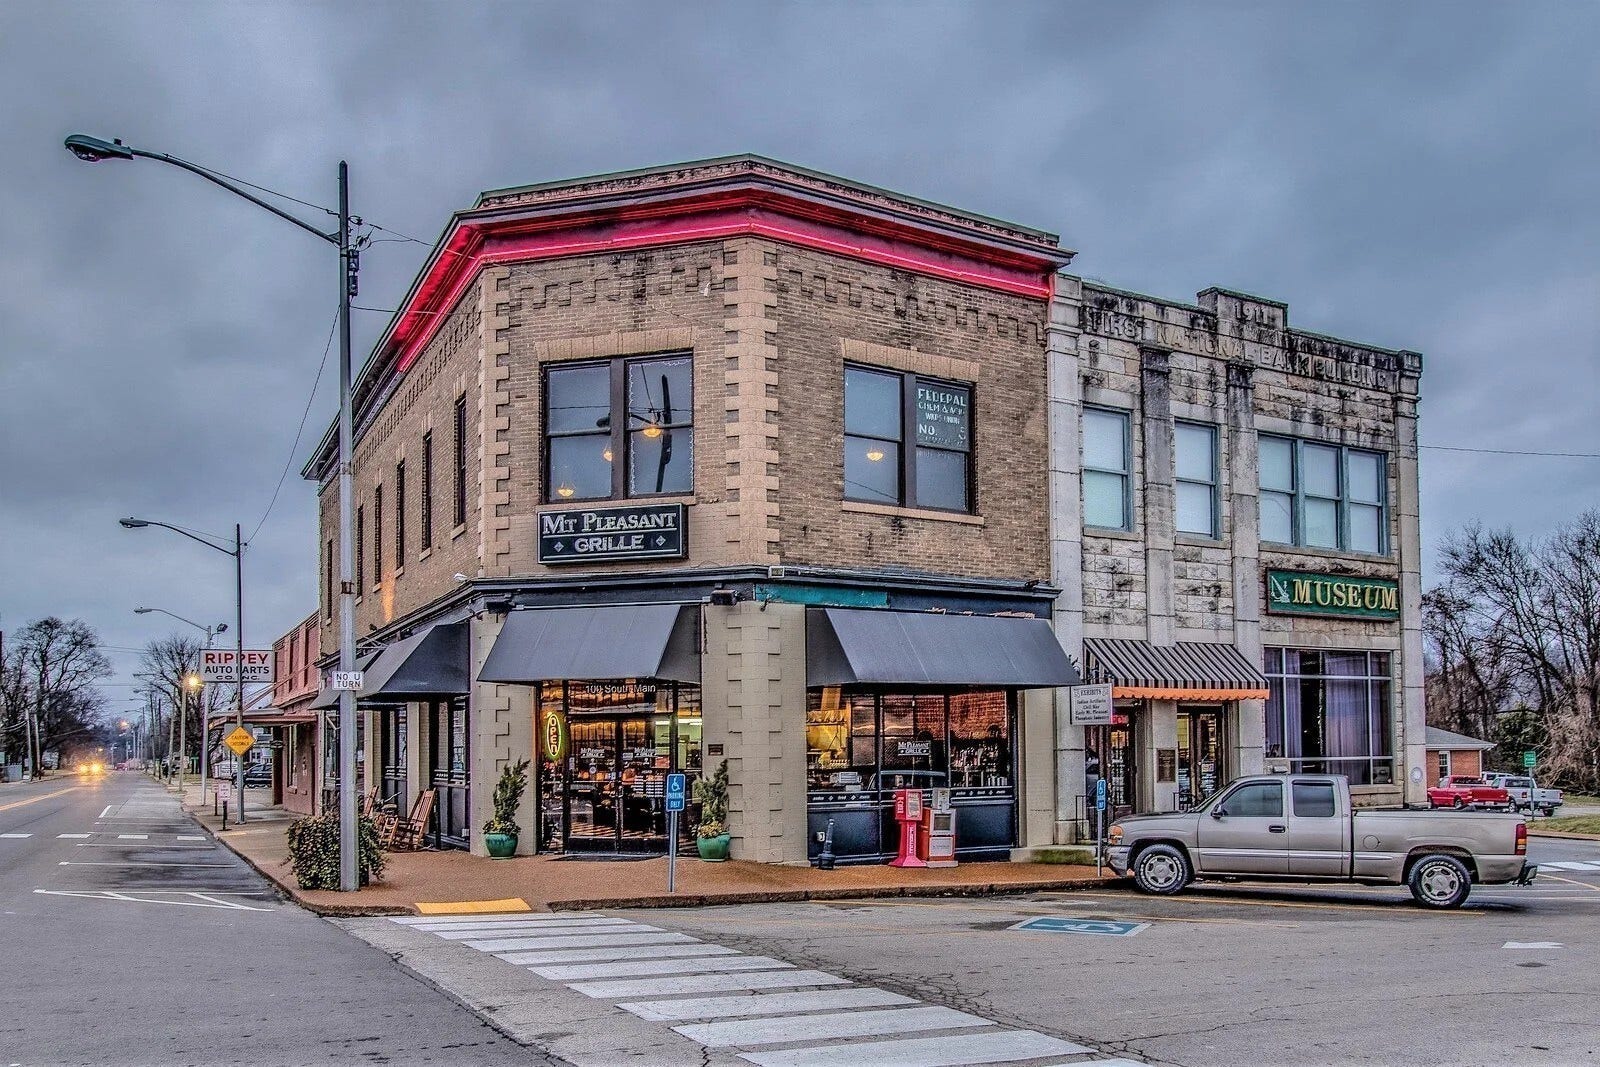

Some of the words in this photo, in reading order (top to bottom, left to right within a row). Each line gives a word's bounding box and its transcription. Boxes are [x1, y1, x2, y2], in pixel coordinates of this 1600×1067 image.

[1233, 301, 1269, 325] 1911
[1091, 309, 1150, 341] FIRST
[1156, 322, 1253, 362] NATIONAL
[1260, 345, 1311, 376] BANK
[581, 512, 677, 532] PLEASANT
[574, 534, 645, 553] GRILLE
[1292, 579, 1399, 611] MUSEUM
[204, 665, 233, 674] AUTO
[336, 673, 349, 681] NO
[353, 673, 361, 681] U
[336, 680, 361, 688] TURN
[604, 685, 631, 694] South
[634, 684, 657, 693] Main
